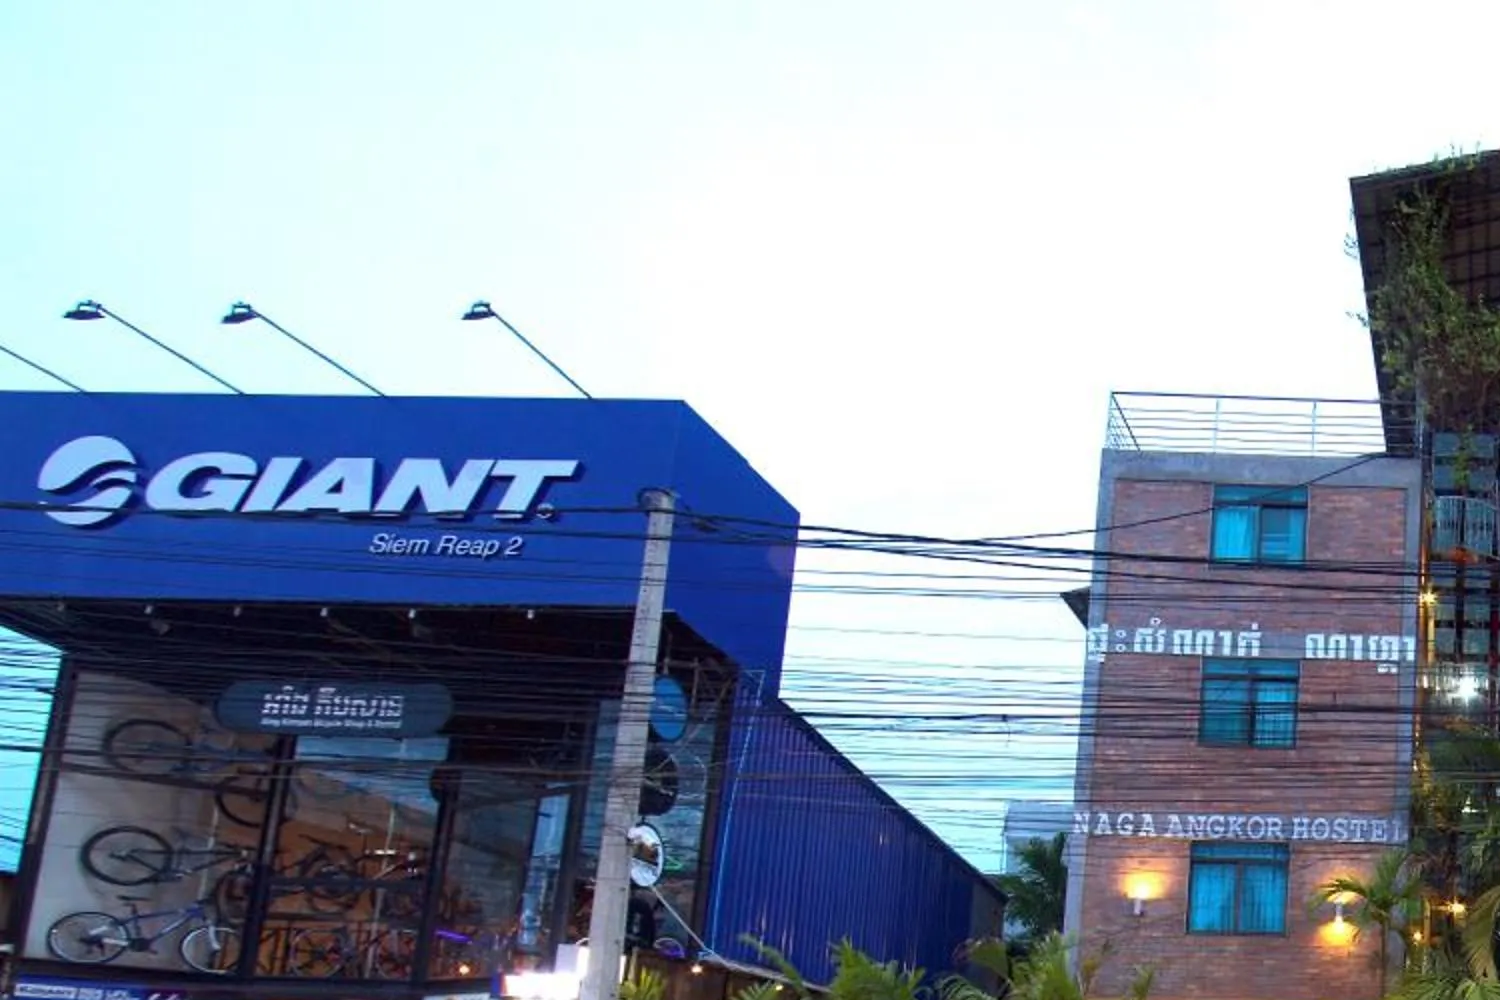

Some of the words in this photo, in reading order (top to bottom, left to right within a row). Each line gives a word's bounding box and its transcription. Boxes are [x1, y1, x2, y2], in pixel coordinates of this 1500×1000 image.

[145, 452, 579, 519] GIANT
[370, 533, 429, 553] Siem
[434, 535, 499, 560] Reap
[504, 536, 523, 555] 2
[1073, 813, 1156, 837] NAGA
[1166, 814, 1284, 840] ANGKOR
